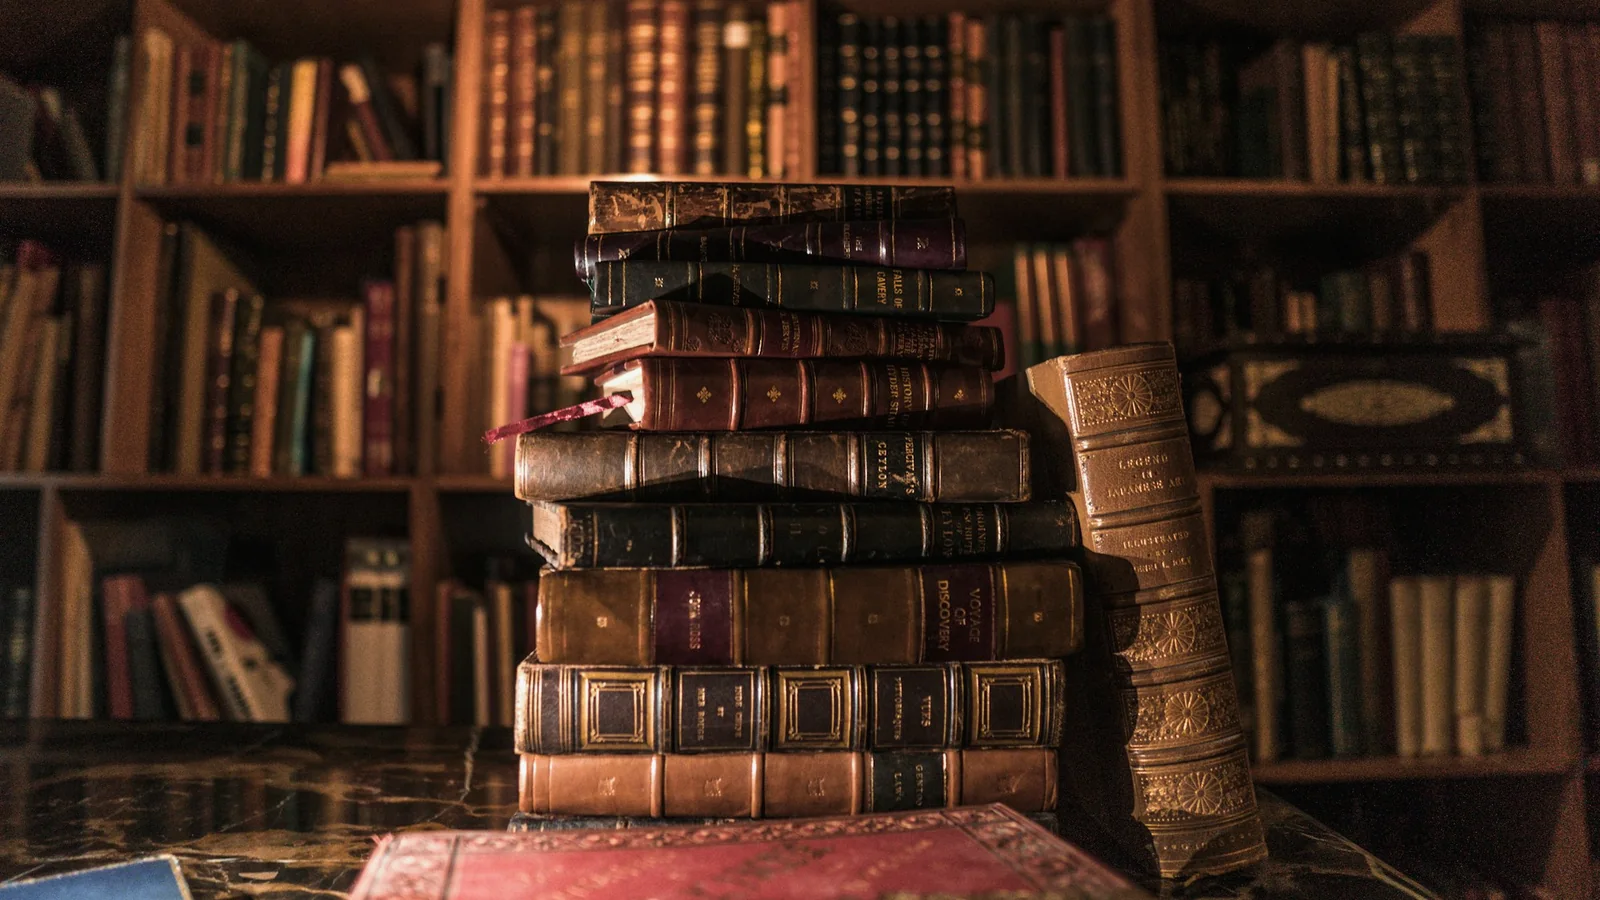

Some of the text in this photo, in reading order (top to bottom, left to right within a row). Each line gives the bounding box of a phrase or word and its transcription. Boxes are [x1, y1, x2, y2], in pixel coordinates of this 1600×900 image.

[876, 271, 887, 305] CAVERY
[893, 269, 903, 309] FALLS OF
[781, 322, 790, 353] JERVIS
[885, 363, 899, 399] HYDER
[900, 367, 913, 411] HISTORY
[877, 441, 887, 489] CEYLON
[904, 436, 915, 495] PERCIVAL'S
[1118, 454, 1169, 470] LEGEND
[1106, 479, 1164, 498] JAPANESE
[1122, 530, 1189, 550] ILLUSTRATED
[688, 590, 701, 650] JOHN ROSS
[936, 579, 950, 652] DISCOVERY
[953, 607, 966, 627] OF
[969, 588, 981, 643] VOYAGE
[920, 695, 932, 728] VUES
[915, 764, 924, 807] GENTOO
